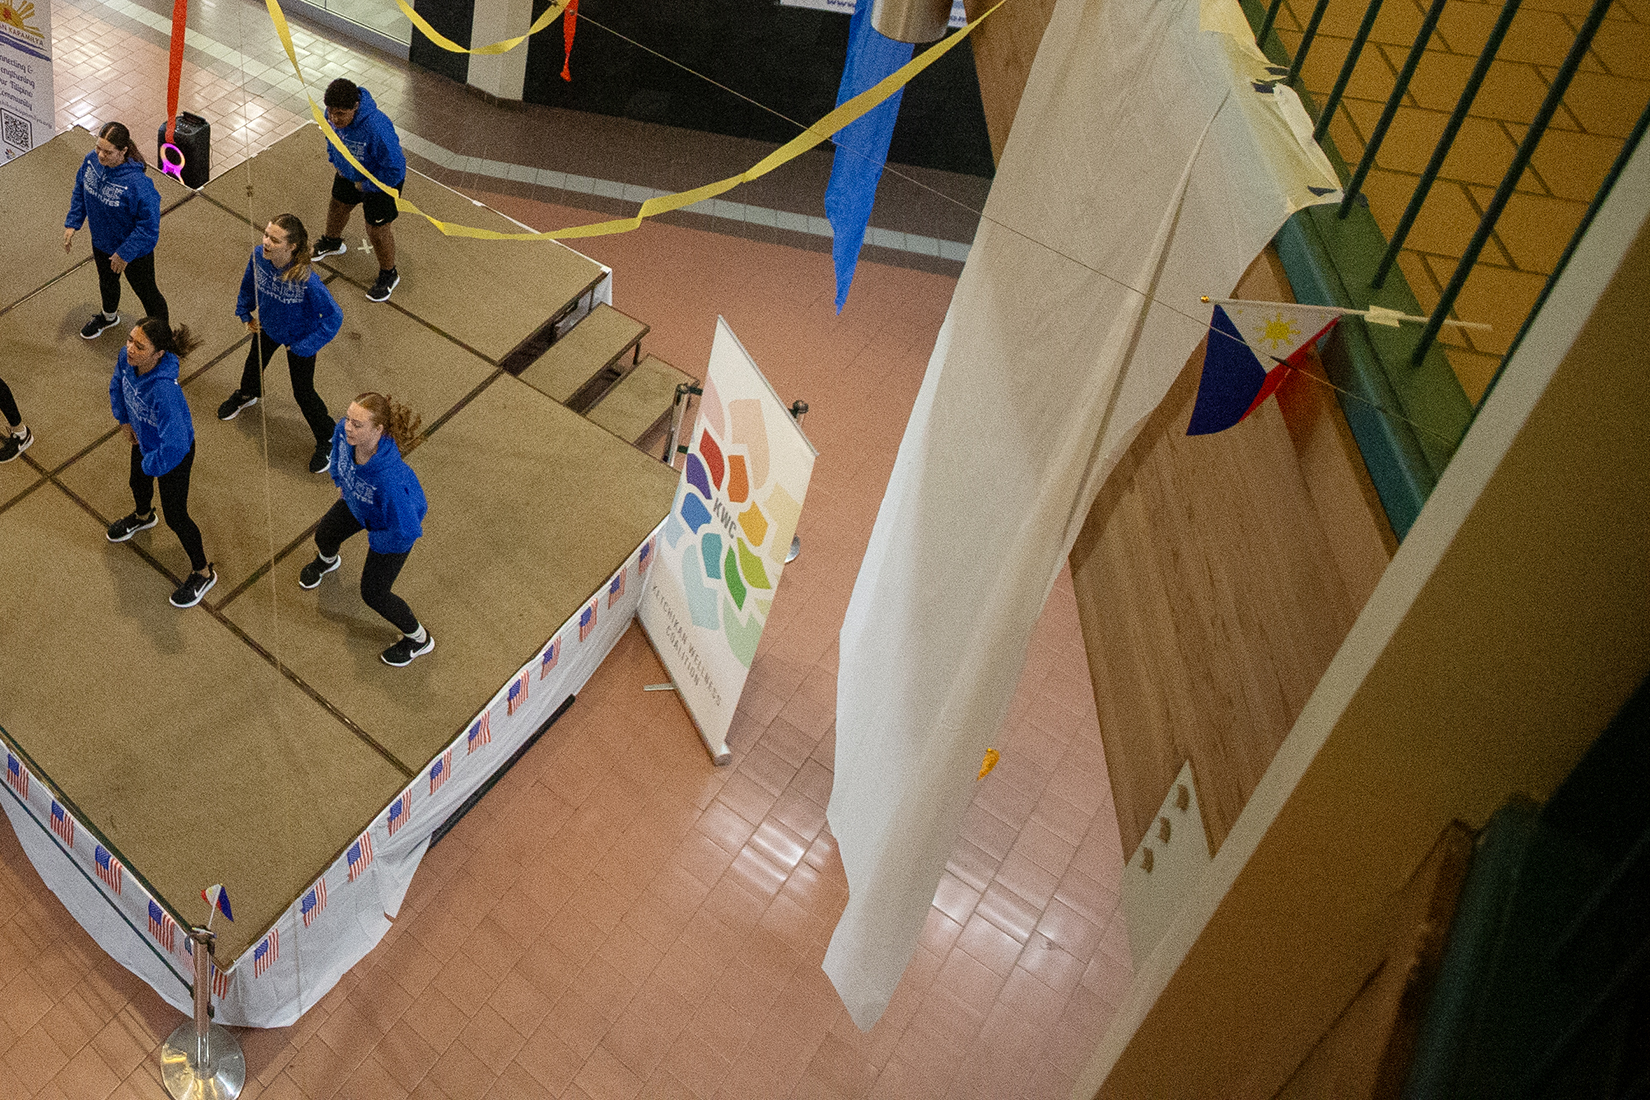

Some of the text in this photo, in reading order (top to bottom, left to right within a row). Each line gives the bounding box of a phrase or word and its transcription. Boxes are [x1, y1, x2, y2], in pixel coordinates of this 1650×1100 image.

[9, 26, 44, 47] KAPAMILYA
[27, 64, 33, 74] &
[10, 80, 33, 97] Filipino
[713, 497, 737, 539] KWC
[652, 585, 722, 707] KETCHIKAN WELLNESS
[666, 626, 700, 687] COALITION
